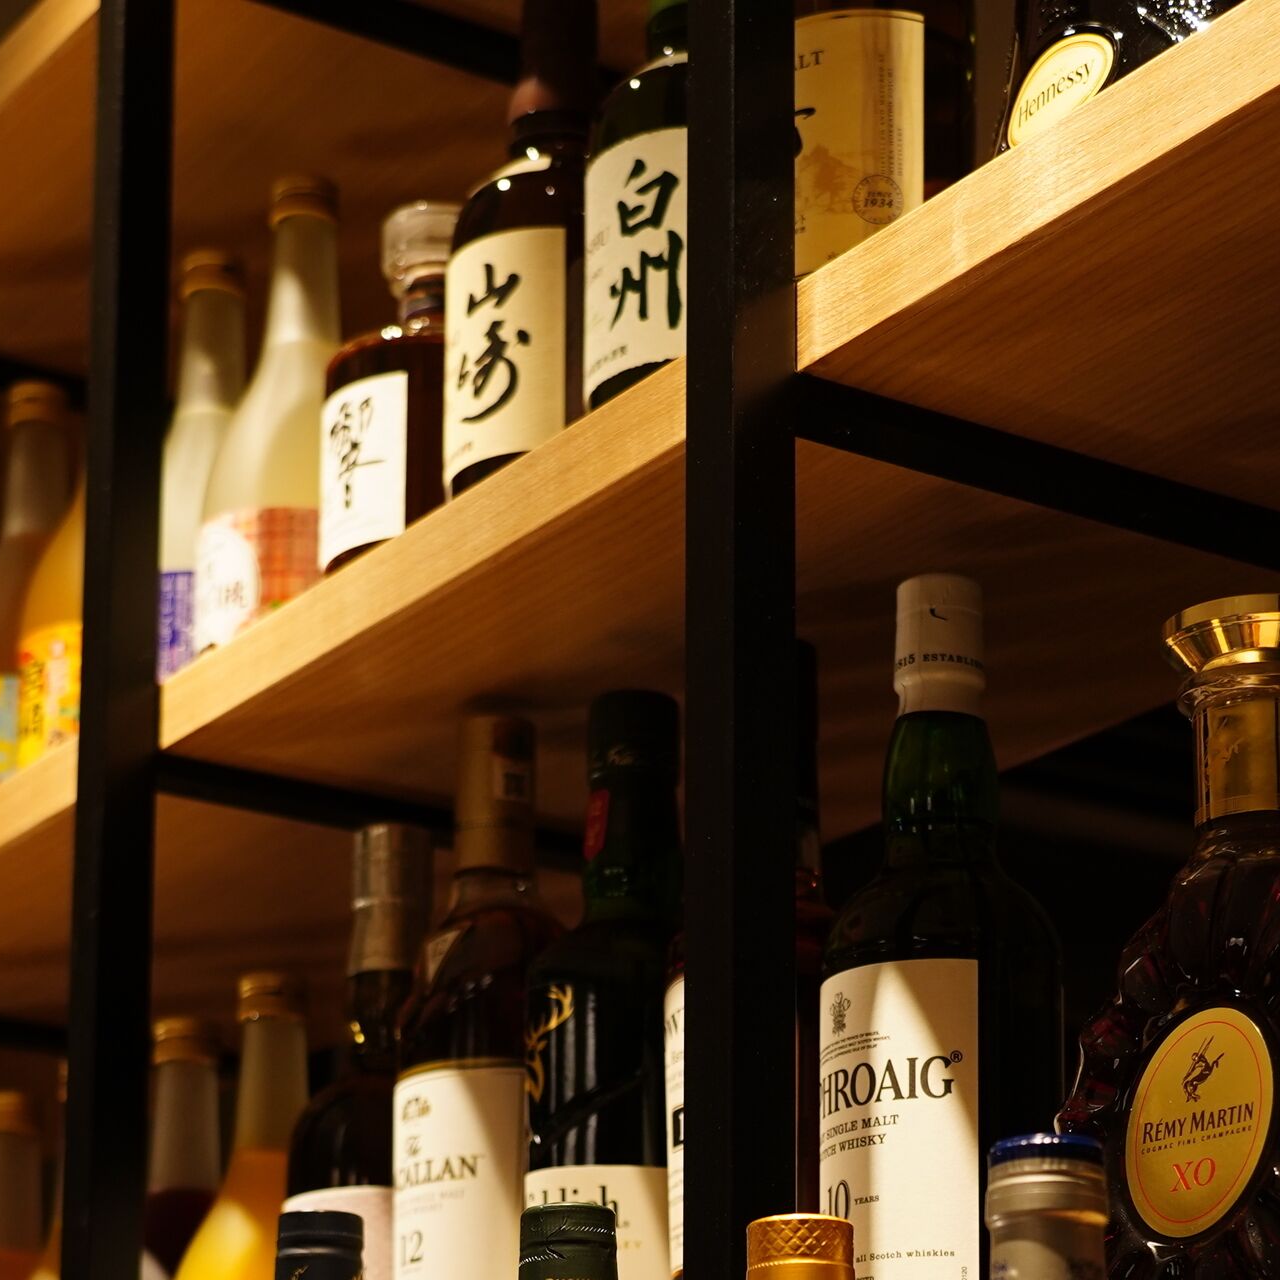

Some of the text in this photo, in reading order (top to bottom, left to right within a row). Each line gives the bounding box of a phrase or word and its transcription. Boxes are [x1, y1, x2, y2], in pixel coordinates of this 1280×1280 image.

[795, 49, 824, 72] LT
[1018, 60, 1096, 128] Hennessy
[863, 198, 894, 209] 1934
[609, 157, 685, 332] 白州
[826, 1114, 900, 1141] SINGLE MALT
[1142, 1102, 1254, 1145] RÉMY MARTIN
[838, 1133, 888, 1153] WHISKY
[1141, 1125, 1252, 1155] COGNAC FINE CHAMPAGNE
[1170, 1157, 1217, 1193] XO
[827, 1179, 880, 1220] 10 YEARS
[856, 1249, 955, 1264] all Scotch whiskies
